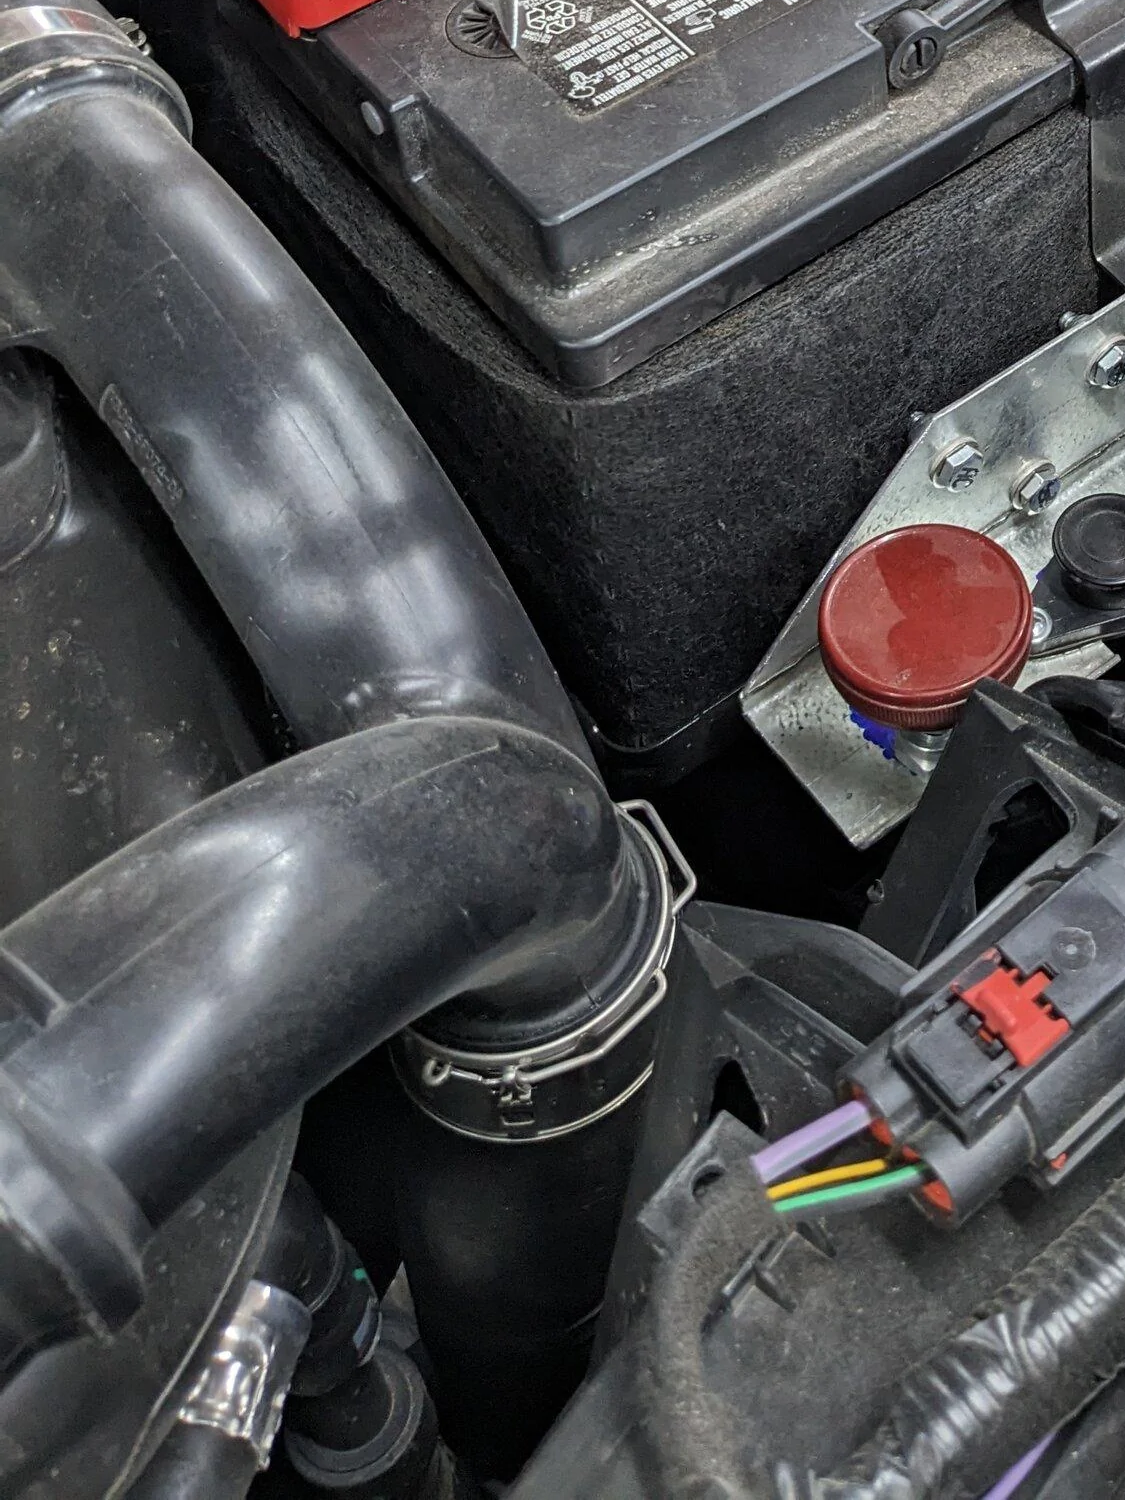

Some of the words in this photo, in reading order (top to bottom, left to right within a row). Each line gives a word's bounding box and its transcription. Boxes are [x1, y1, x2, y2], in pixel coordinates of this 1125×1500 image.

[599, 12, 645, 39] CONSULTEZ
[587, 33, 604, 45] UN
[616, 40, 635, 53] LES
[637, 35, 672, 56] MEDICAL
[594, 47, 620, 64] YEUX
[619, 51, 642, 66] HELP
[655, 43, 680, 59] WITH
[659, 50, 689, 69] FLUSH
[611, 69, 631, 82] GET
[640, 63, 664, 79] EYES
[589, 73, 645, 106] IMMEDIATELY
